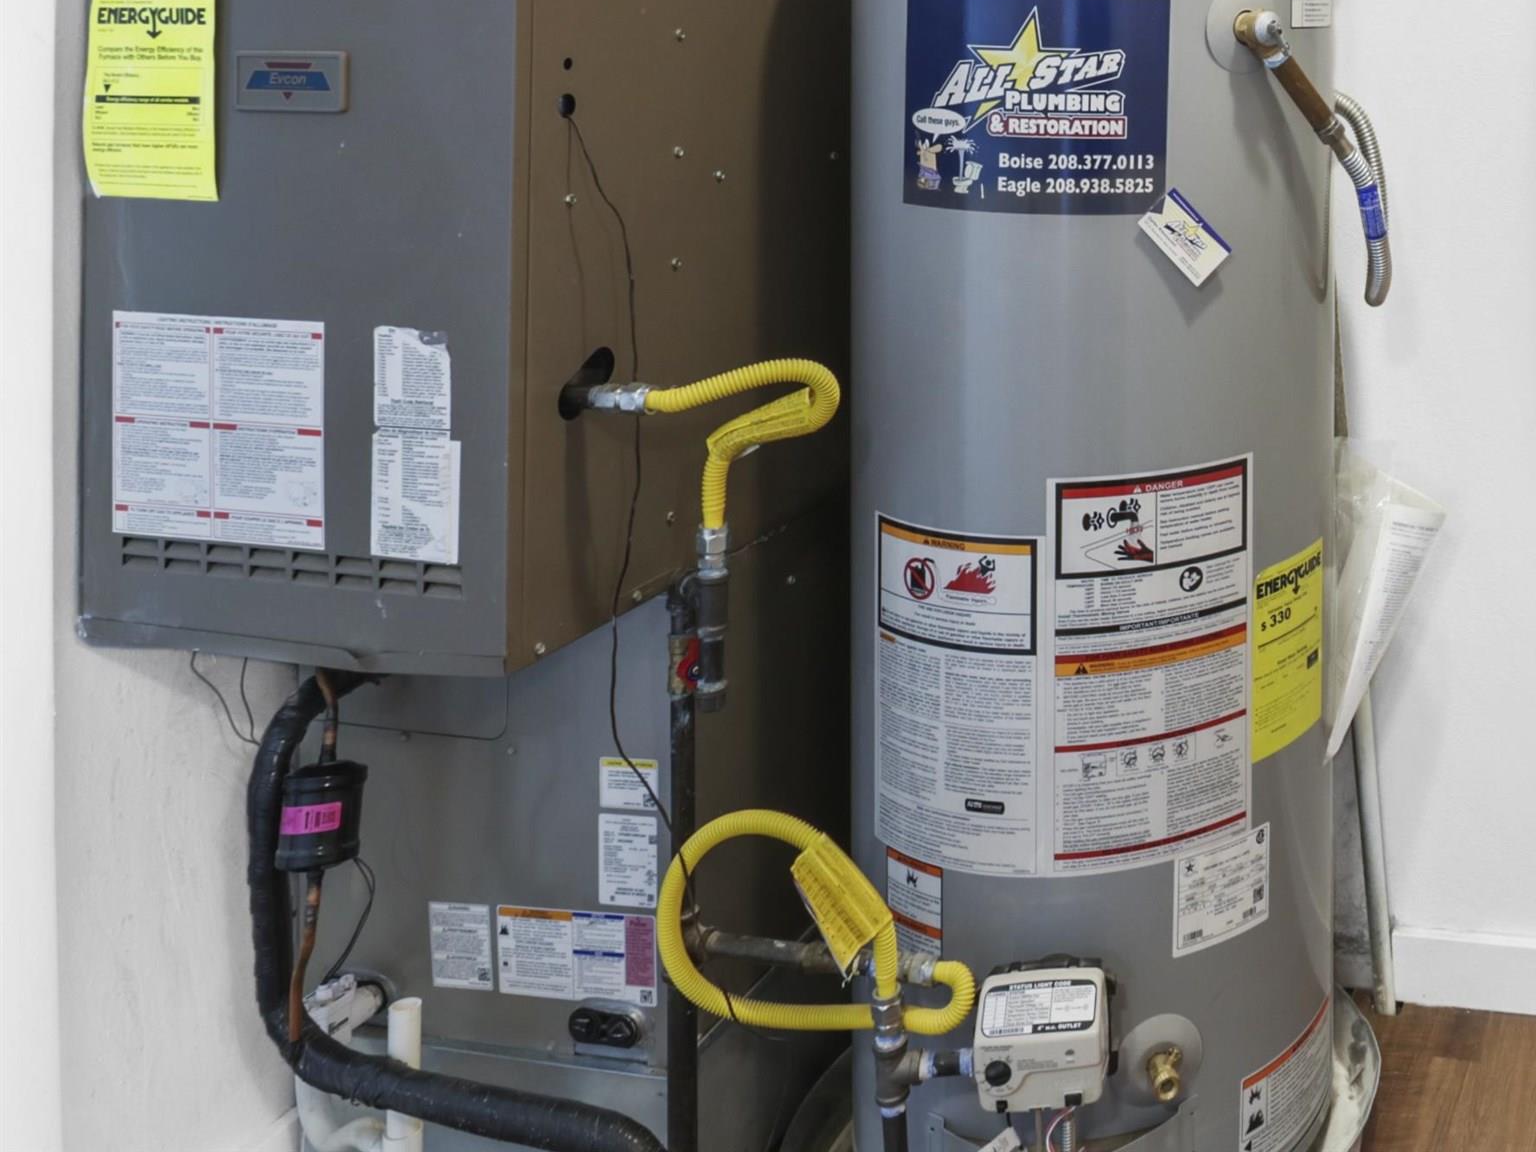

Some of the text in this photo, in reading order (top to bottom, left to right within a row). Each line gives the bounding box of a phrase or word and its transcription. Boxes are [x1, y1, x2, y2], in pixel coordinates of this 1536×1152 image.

[97, 6, 207, 26] ENERGYGUIDE
[269, 72, 307, 86] Evcon
[933, 51, 1122, 108] ALL STAR
[1004, 91, 1122, 113] PLUMBING
[989, 116, 1125, 136] & RESTORATION
[998, 153, 1155, 171] Boise 208.377.0113
[997, 177, 1154, 197] Eagle 208.938.5825
[1144, 479, 1184, 493] DANGER
[928, 538, 966, 551] WARNING
[1256, 551, 1322, 600] ENERGYGUIDE
[1269, 608, 1292, 629] 330
